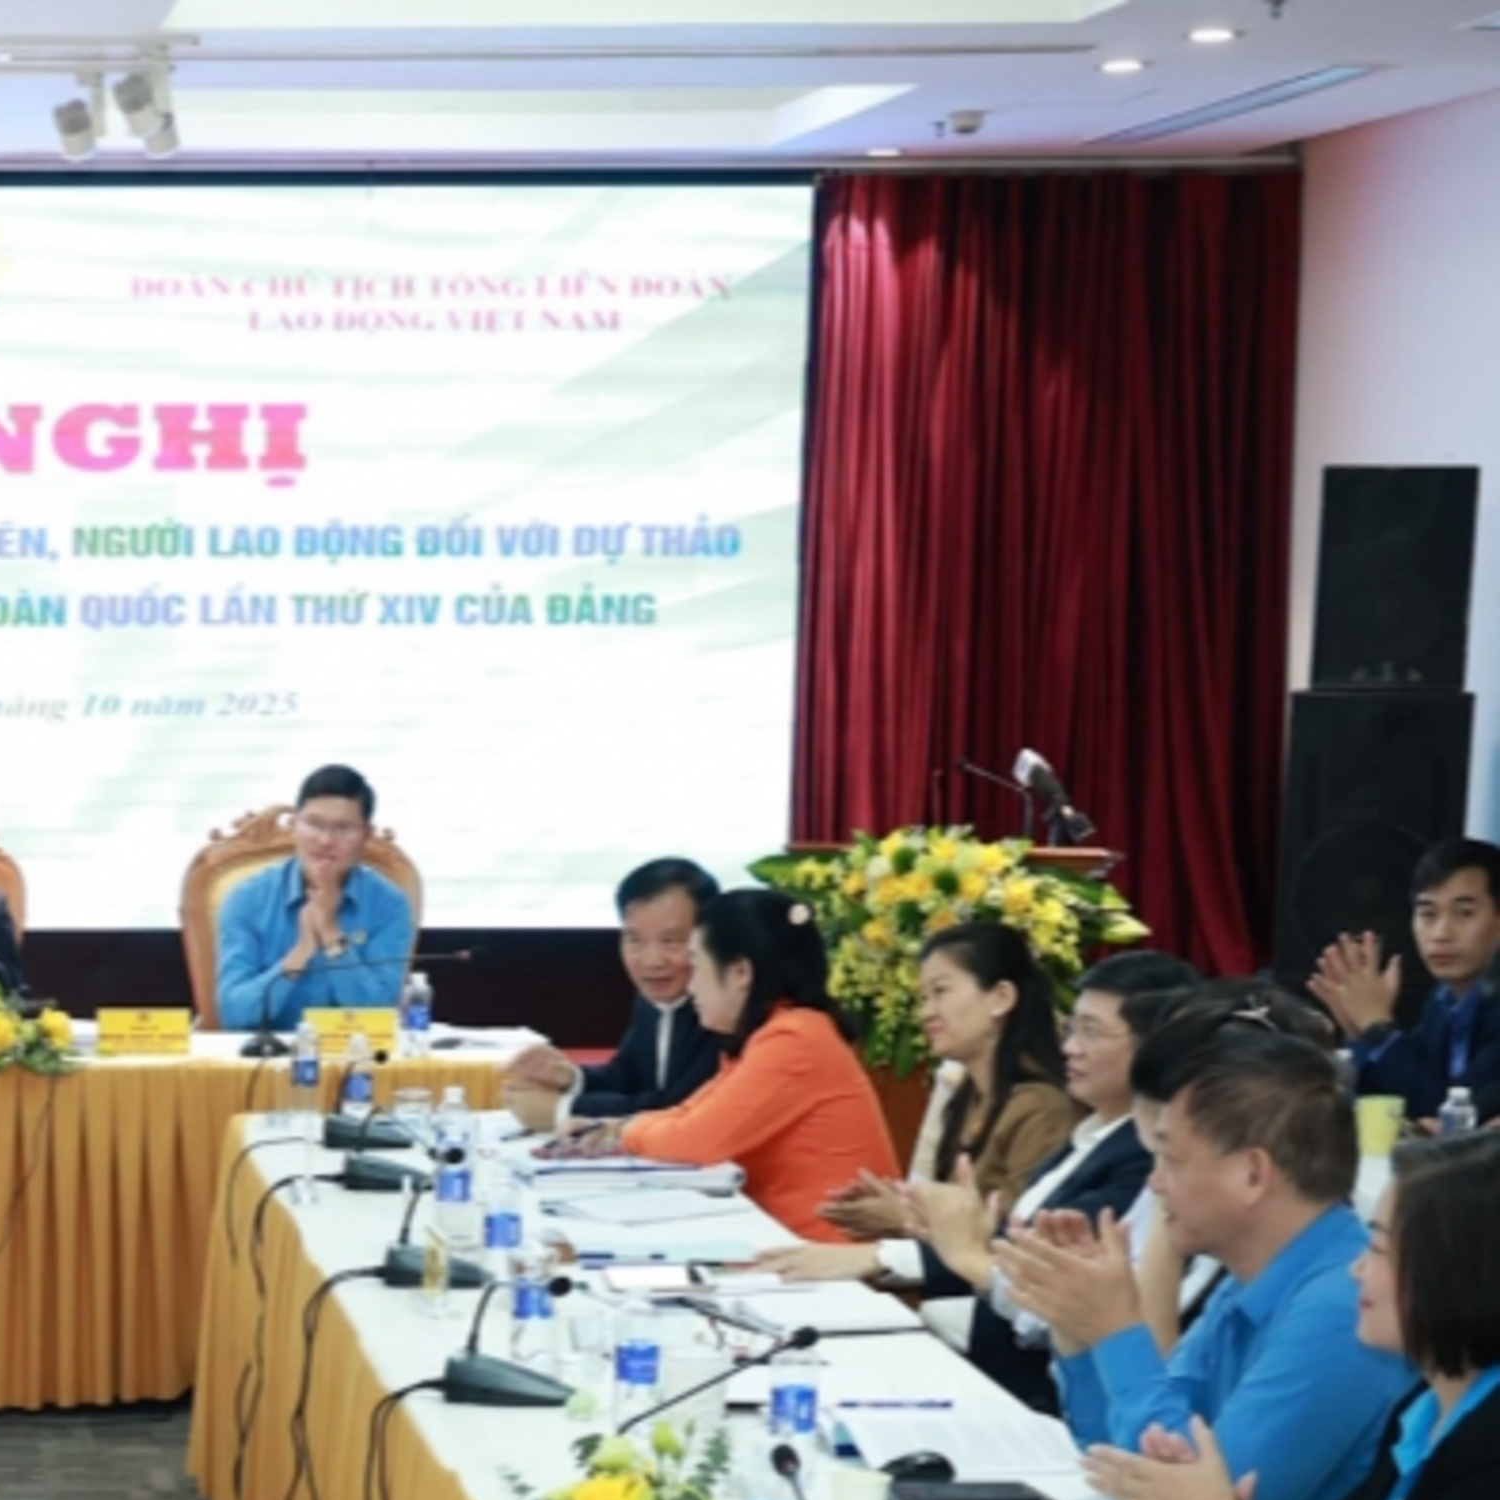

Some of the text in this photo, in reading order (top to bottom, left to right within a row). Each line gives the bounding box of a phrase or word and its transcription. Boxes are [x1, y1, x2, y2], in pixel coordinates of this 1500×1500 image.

[247, 308, 324, 333] LAO
[540, 308, 622, 333] NAM
[72, 517, 195, 559] NGƯỜI
[207, 525, 283, 558] LAO
[292, 519, 405, 566] ĐỘNG
[415, 514, 484, 558] ĐỐI
[496, 517, 561, 558] VỚI
[572, 521, 632, 565] DỰ
[640, 514, 743, 558] THẢO
[80, 582, 187, 631] QUỐC
[290, 588, 369, 626] THỨ
[378, 594, 442, 626] XIV
[453, 583, 535, 626] CỦA
[545, 582, 658, 626] ĐẢNG
[79, 692, 123, 718] 10
[129, 692, 208, 718] năm
[216, 690, 300, 718] 2025
